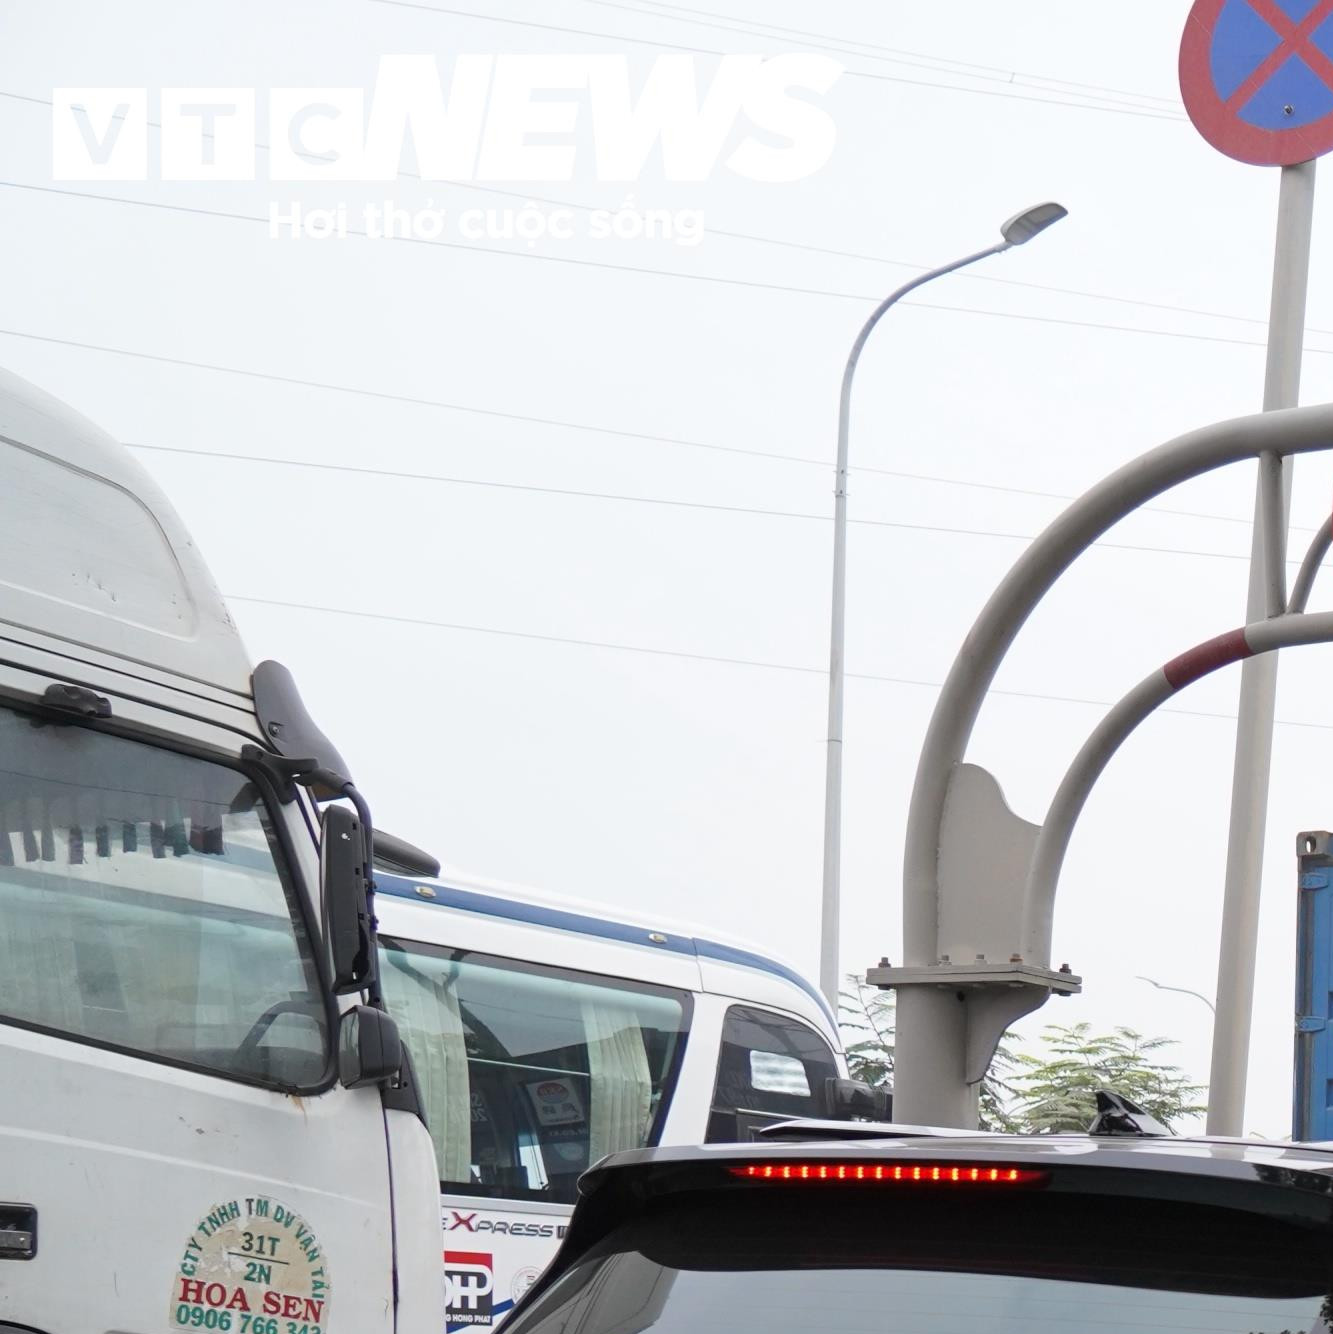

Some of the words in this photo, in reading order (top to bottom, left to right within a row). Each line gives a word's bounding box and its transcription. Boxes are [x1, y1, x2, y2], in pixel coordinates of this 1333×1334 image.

[181, 1237, 203, 1277] CTY
[198, 1201, 241, 1237] TNHH
[245, 1198, 269, 1217] TM
[273, 1205, 296, 1228] DV
[241, 1231, 280, 1257] 31T
[244, 1262, 272, 1285] 2N
[178, 1277, 250, 1312] HOA
[262, 1290, 324, 1323] SEN
[176, 1304, 232, 1331] 0906
